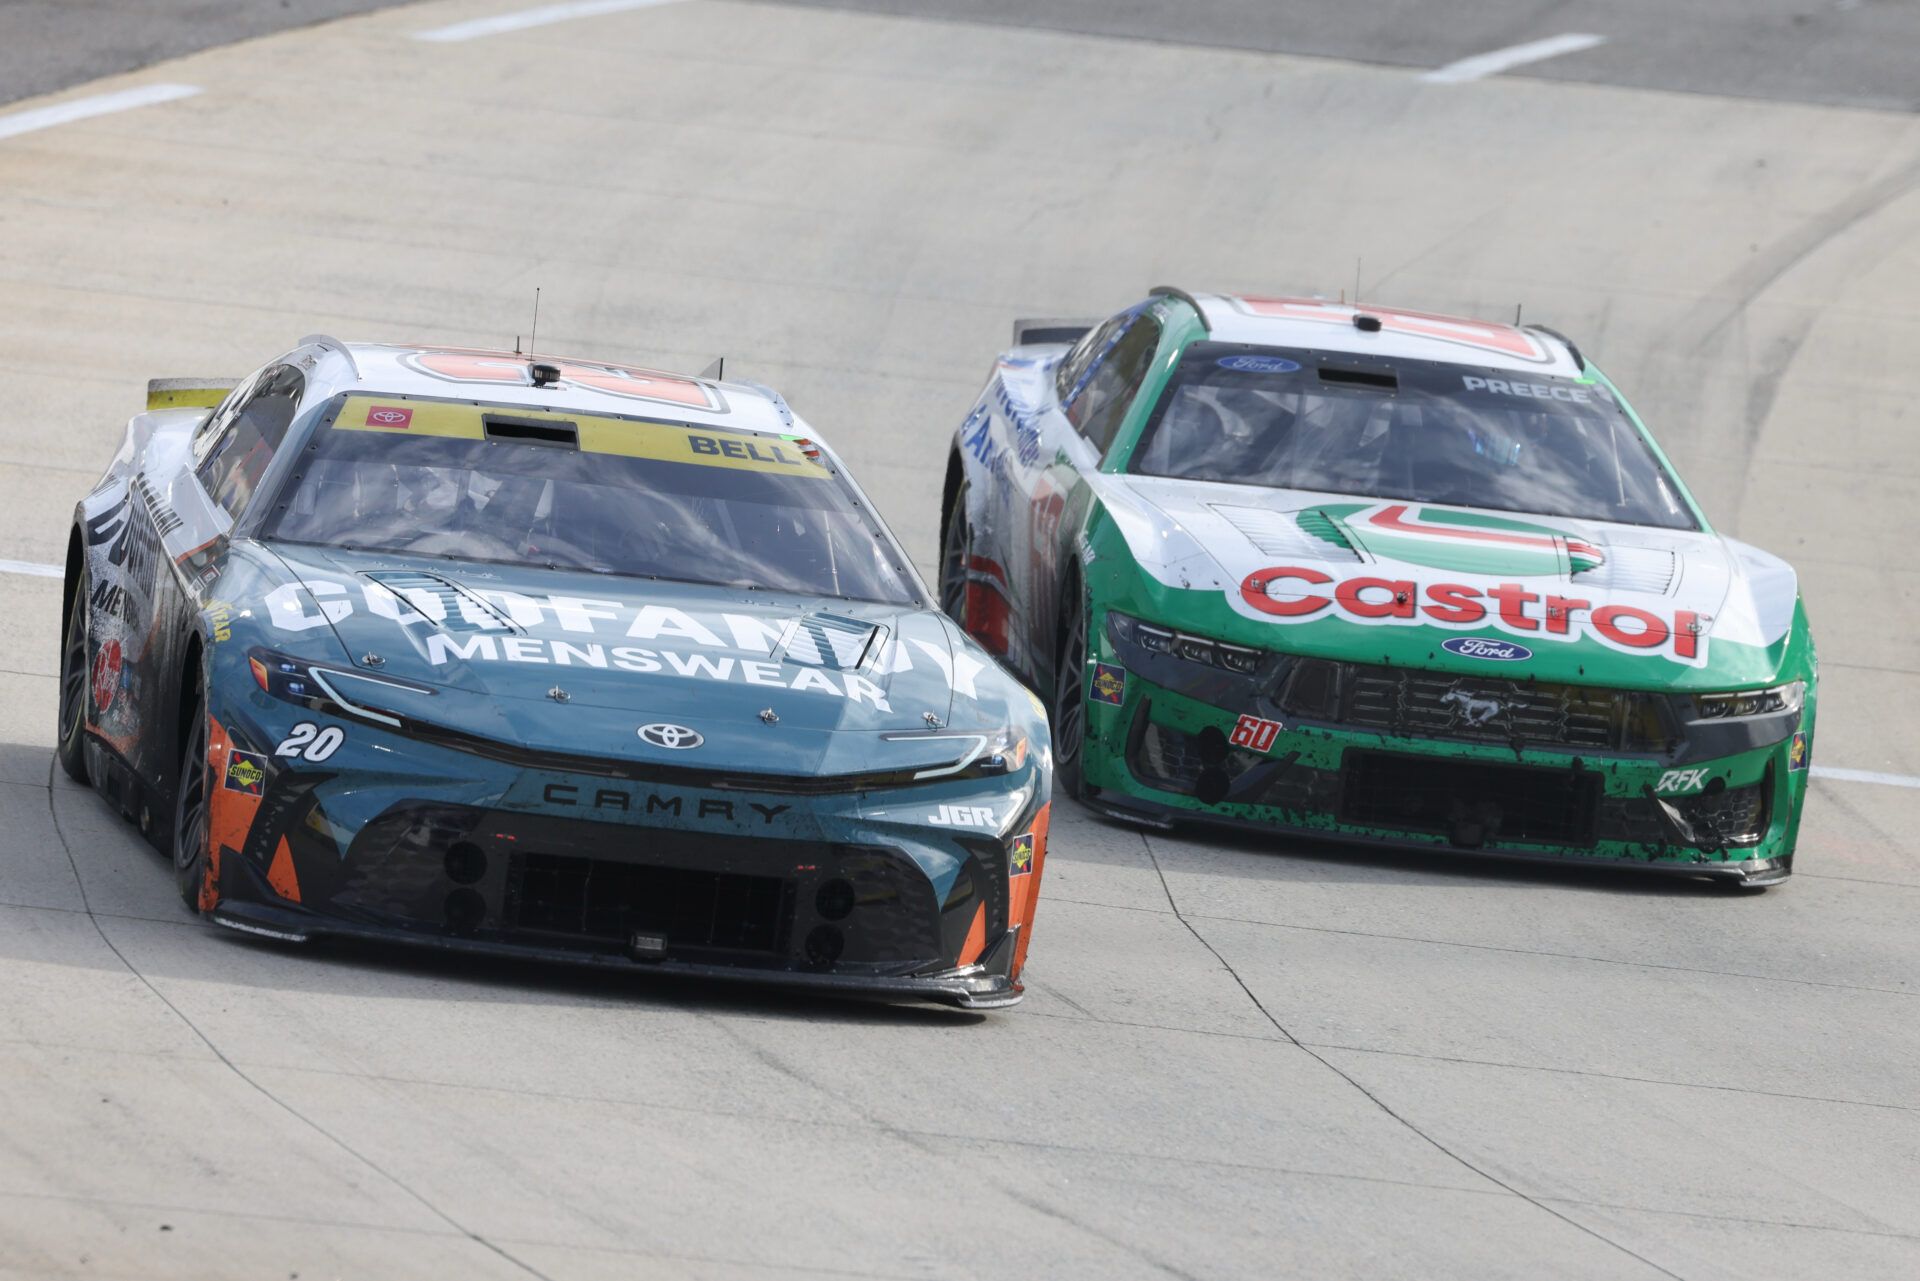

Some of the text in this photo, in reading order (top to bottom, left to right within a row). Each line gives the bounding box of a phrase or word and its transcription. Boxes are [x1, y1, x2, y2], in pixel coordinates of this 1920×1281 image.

[1461, 375, 1592, 404] PREECE
[688, 435, 802, 465] BELL
[1241, 566, 1698, 660] Castrol
[264, 580, 986, 701] COOFANDY
[1459, 639, 1514, 659] Ford
[426, 633, 893, 714] MENSWEAR
[274, 722, 344, 762] 20
[1229, 714, 1283, 752] 60
[230, 764, 264, 783] SUNOCO
[1654, 767, 1710, 792] RFK
[543, 783, 792, 824] CAMRY
[928, 804, 998, 828] JGR
